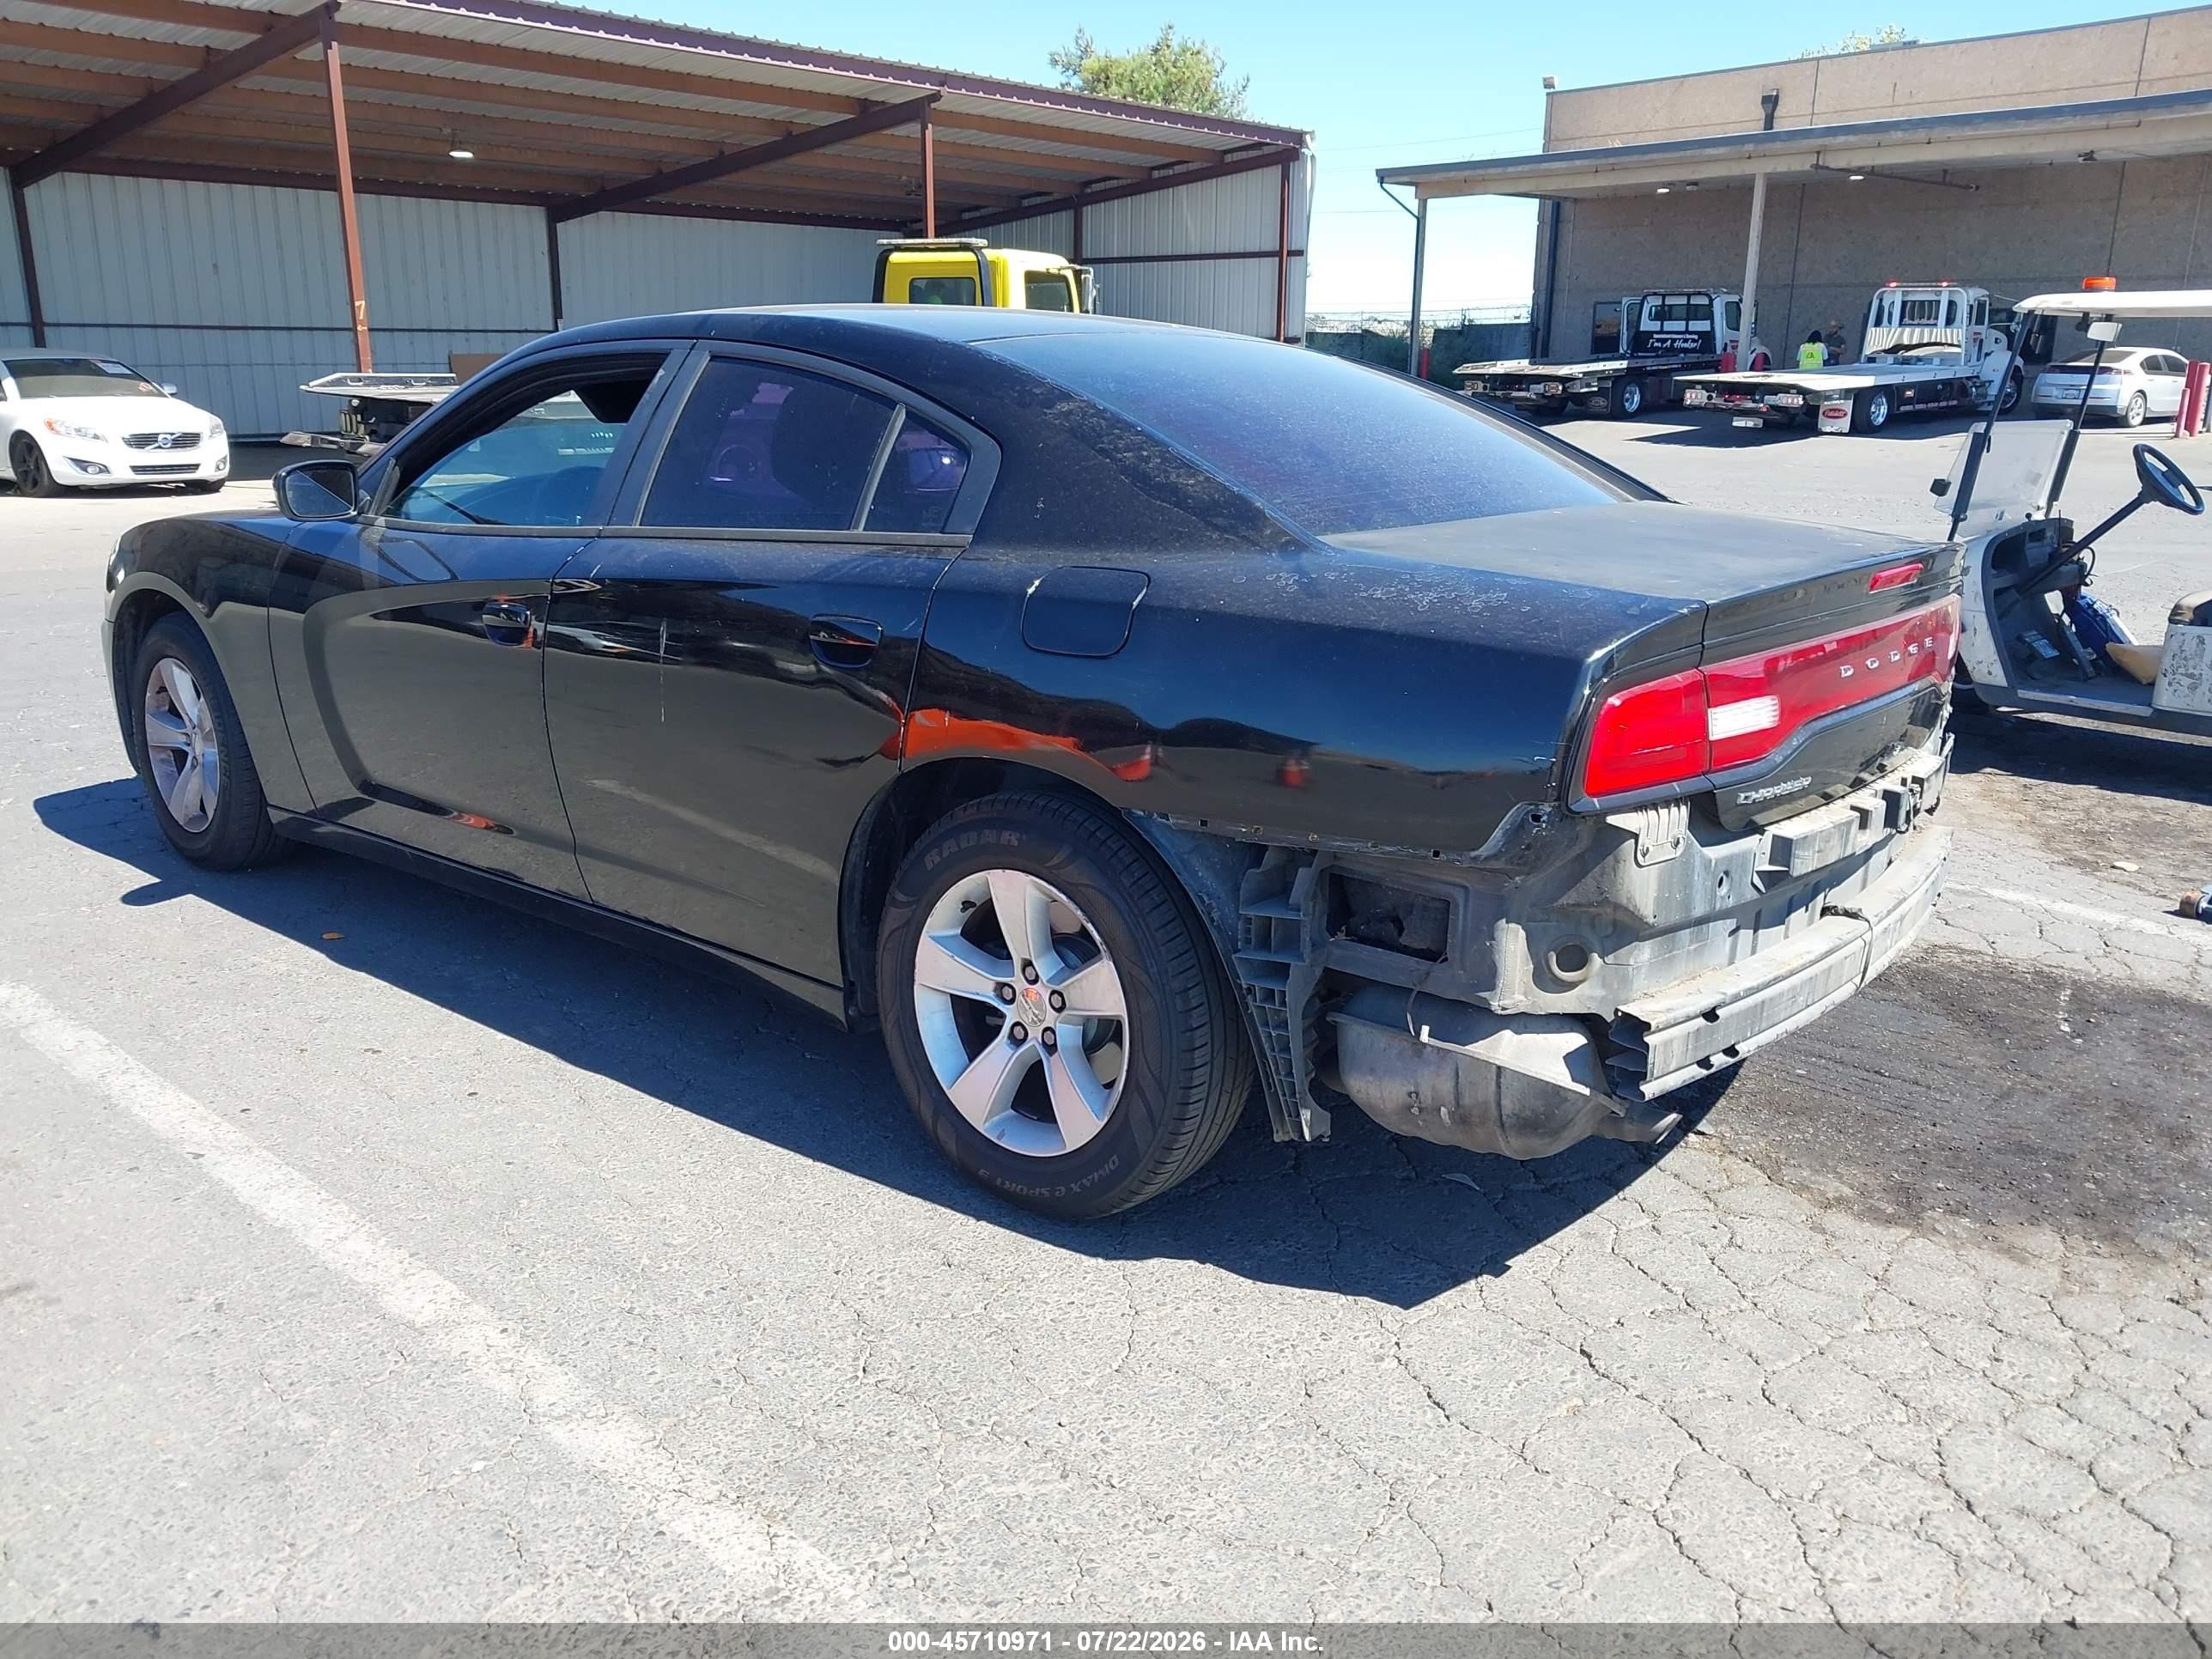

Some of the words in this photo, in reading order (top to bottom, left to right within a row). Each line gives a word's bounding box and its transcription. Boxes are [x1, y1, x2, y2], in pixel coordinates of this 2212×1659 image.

[355, 301, 365, 319] 7
[1662, 339, 1671, 348] A
[1839, 636, 1933, 678] DODGE
[924, 829, 1021, 871] RADAR
